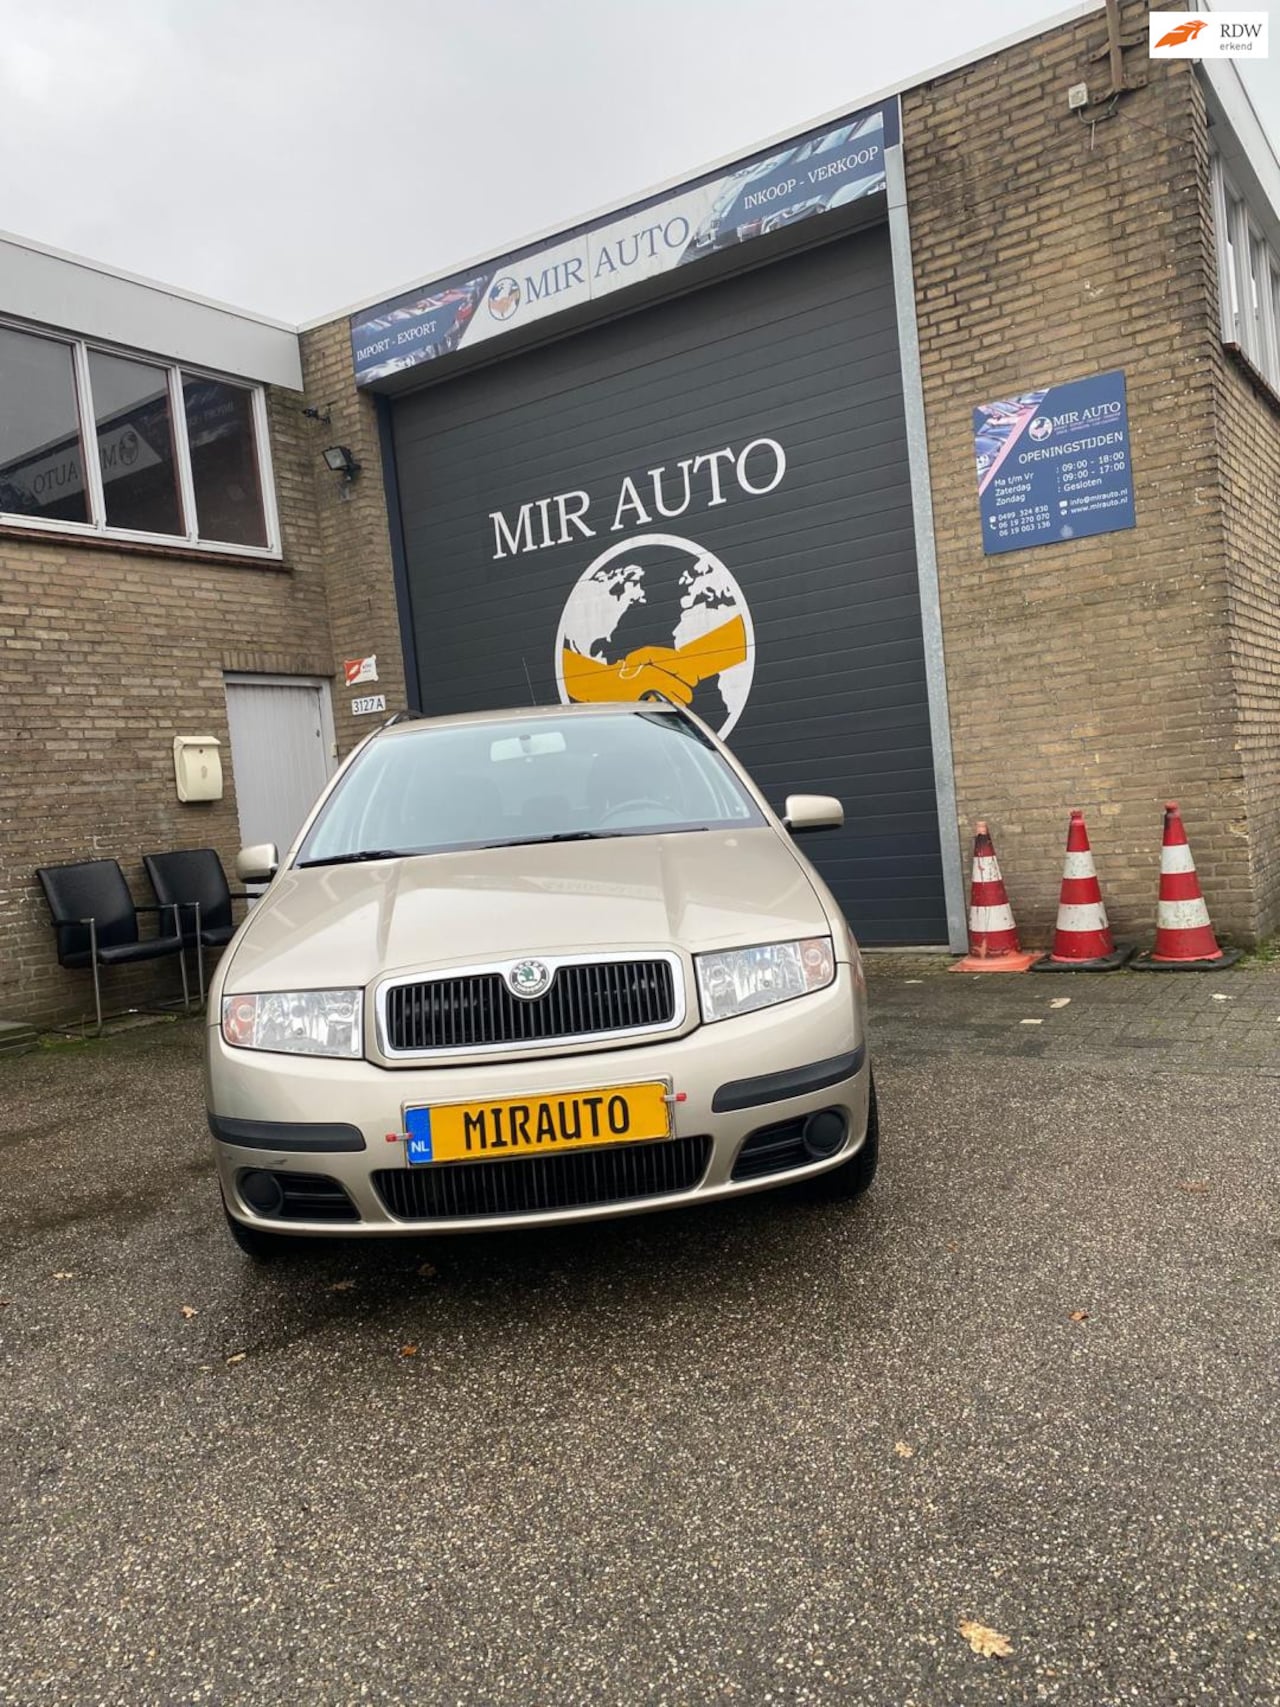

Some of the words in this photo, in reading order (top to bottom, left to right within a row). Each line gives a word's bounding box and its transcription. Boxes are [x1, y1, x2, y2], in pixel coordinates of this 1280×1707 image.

[744, 178, 797, 209] INKOOP
[808, 146, 879, 184] VERKOOP
[525, 257, 585, 305] MIR
[594, 216, 690, 279] AUTO
[356, 338, 390, 361] IMPORT
[397, 320, 437, 345] EXPORT
[1053, 411, 1079, 427] MIR
[1082, 401, 1121, 420] AUTO
[1018, 431, 1124, 465] OPENINGSTIJDEN
[995, 483, 1031, 497] Zaterdag
[1062, 469, 1089, 482] 09:00
[1100, 461, 1126, 474] 17:00
[1008, 475, 1023, 485] t/m
[1024, 472, 1034, 480] Vr
[1062, 459, 1088, 472] 09:00
[1099, 451, 1125, 464] 18:00
[488, 490, 597, 560] MIR
[610, 438, 787, 532] AUTO
[996, 494, 1026, 506] Zondag
[1063, 478, 1102, 492] Gesloten
[1070, 488, 1128, 506] info@mirauto.nl
[1071, 496, 1128, 513] www.mirauto.nl
[463, 1095, 630, 1152] MIRAUTO
[411, 1140, 430, 1153] NL
